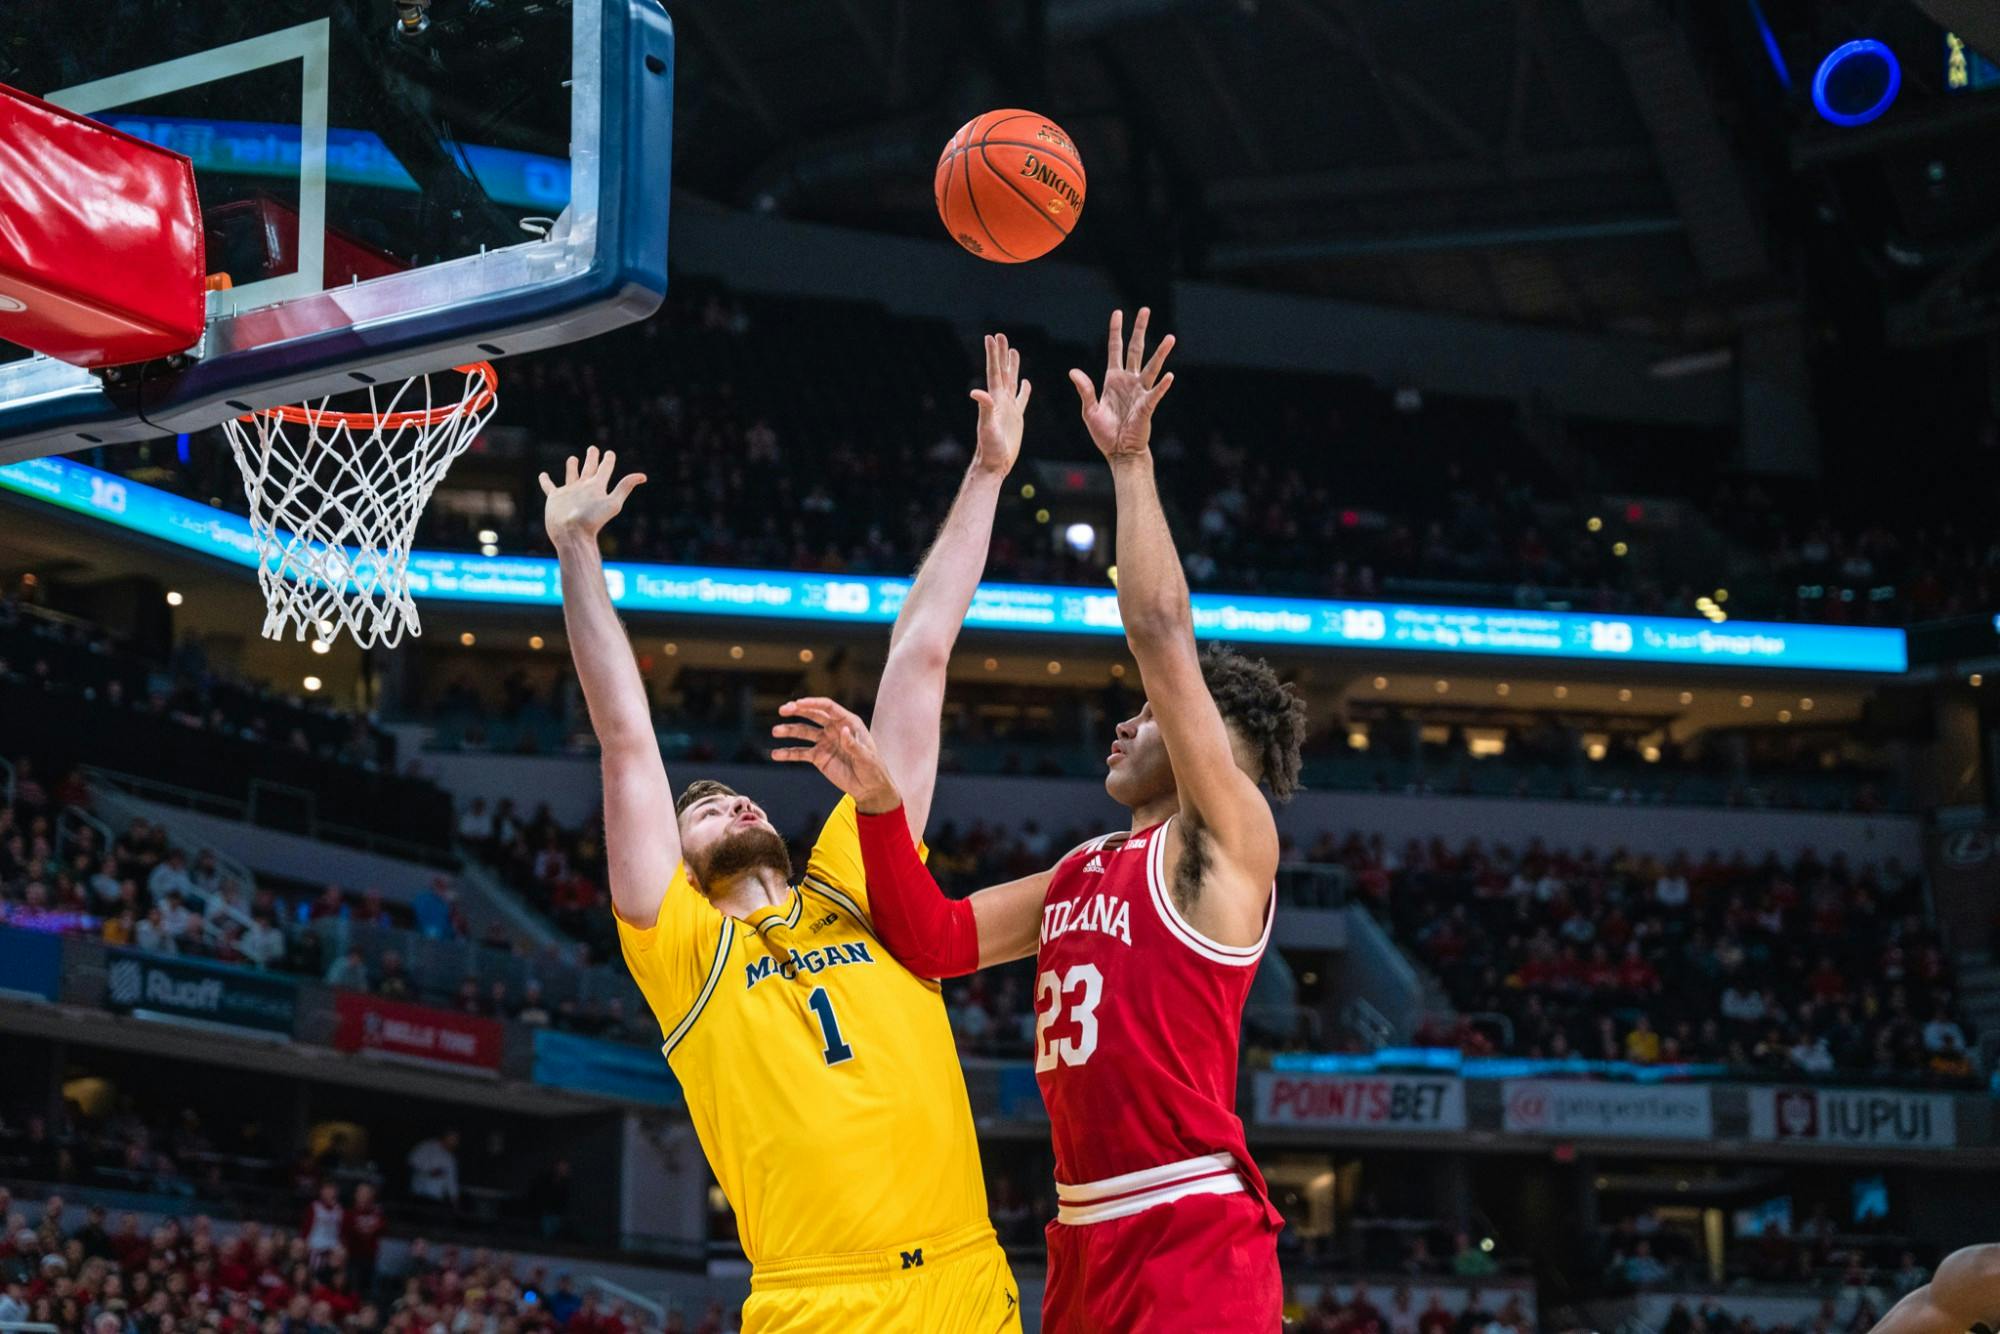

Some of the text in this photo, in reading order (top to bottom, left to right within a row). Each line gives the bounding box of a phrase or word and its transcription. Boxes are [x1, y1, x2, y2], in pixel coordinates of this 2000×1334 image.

[1041, 893, 1132, 948] NDIANA
[807, 985, 855, 1067] 1
[1035, 962, 1104, 1074] 23
[1827, 1098, 1931, 1140] IUPUI
[900, 1247, 924, 1270] M
